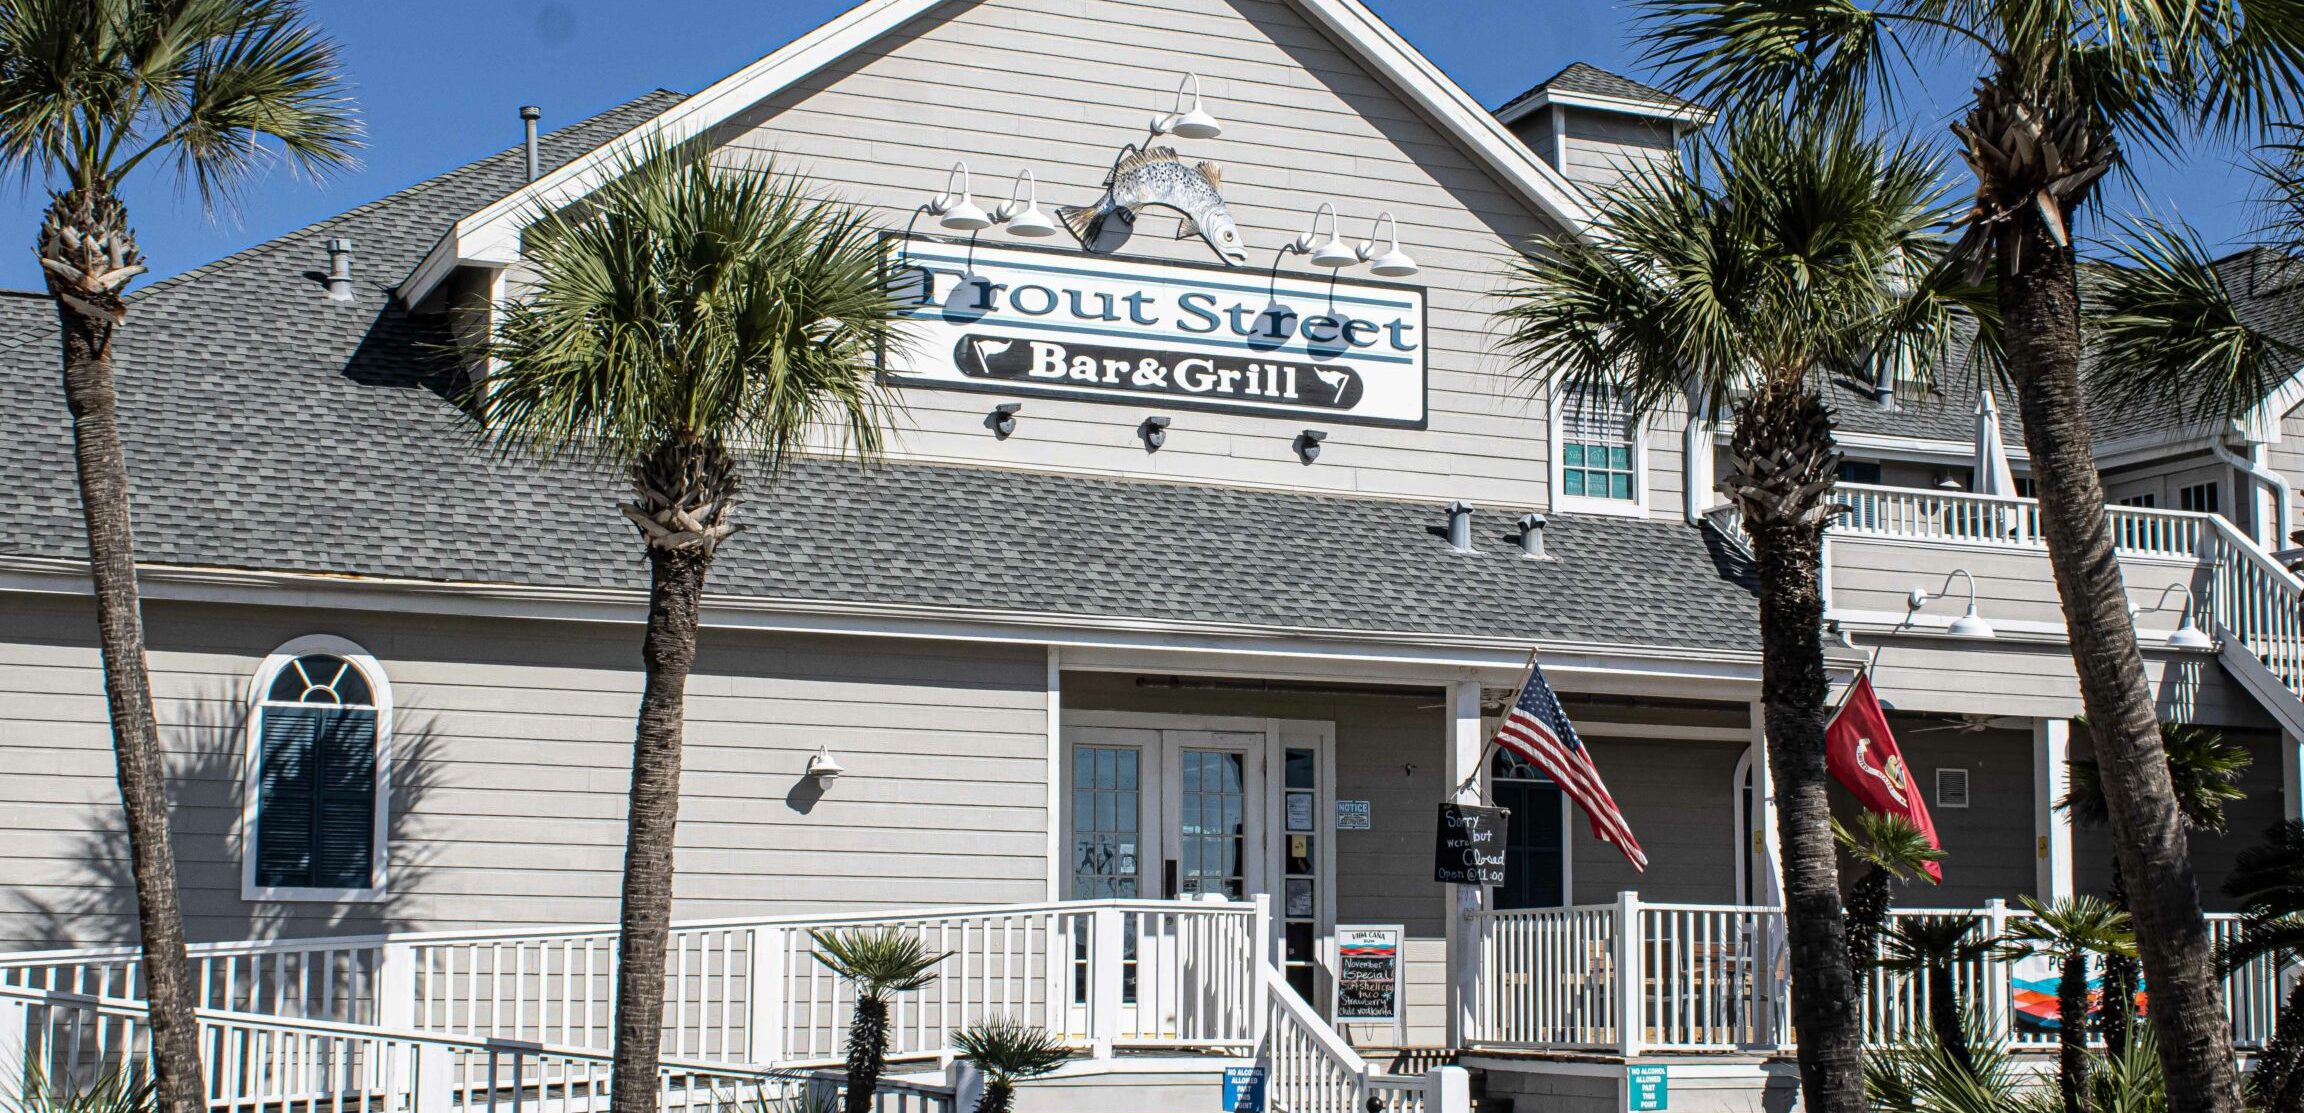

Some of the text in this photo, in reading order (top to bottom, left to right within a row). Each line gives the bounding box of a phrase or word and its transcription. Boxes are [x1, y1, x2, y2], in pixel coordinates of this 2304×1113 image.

[893, 264, 1418, 351] Trout Street
[1028, 342, 1299, 399] Bar&Grill
[1339, 803, 1367, 812] NOTICE
[1446, 810, 1492, 842] Sorry but
[1463, 849, 1504, 867] Closed
[1439, 868, 1464, 880] Open
[1345, 958, 1383, 968] November
[1227, 1068, 1236, 1076] NO
[1641, 1067, 1666, 1075] ALCOHOL
